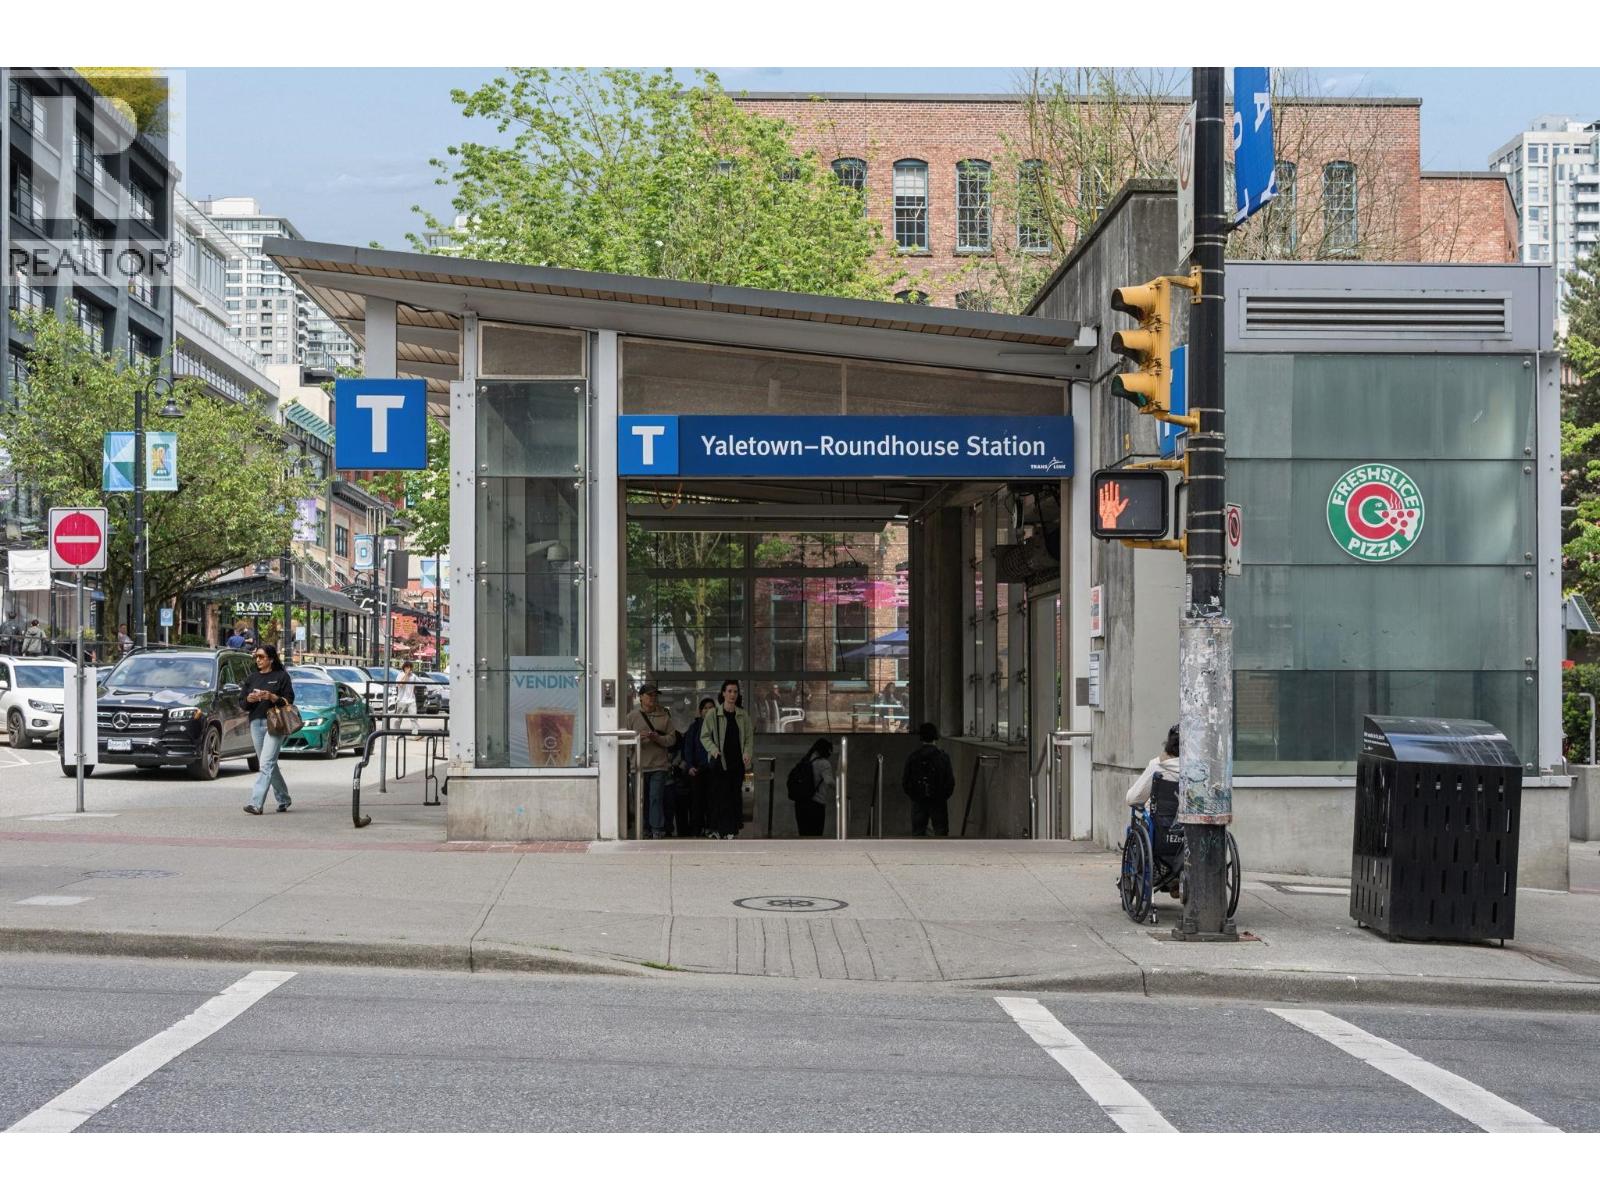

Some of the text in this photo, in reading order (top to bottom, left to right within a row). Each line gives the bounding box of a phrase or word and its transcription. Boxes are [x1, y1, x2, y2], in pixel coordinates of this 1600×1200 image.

[356, 395, 405, 453] T
[631, 425, 666, 465] T
[966, 434, 1046, 457] Station
[1331, 467, 1420, 508] FRESHSLICE
[1347, 537, 1403, 557] PIZZA
[235, 601, 273, 612] RAY'S
